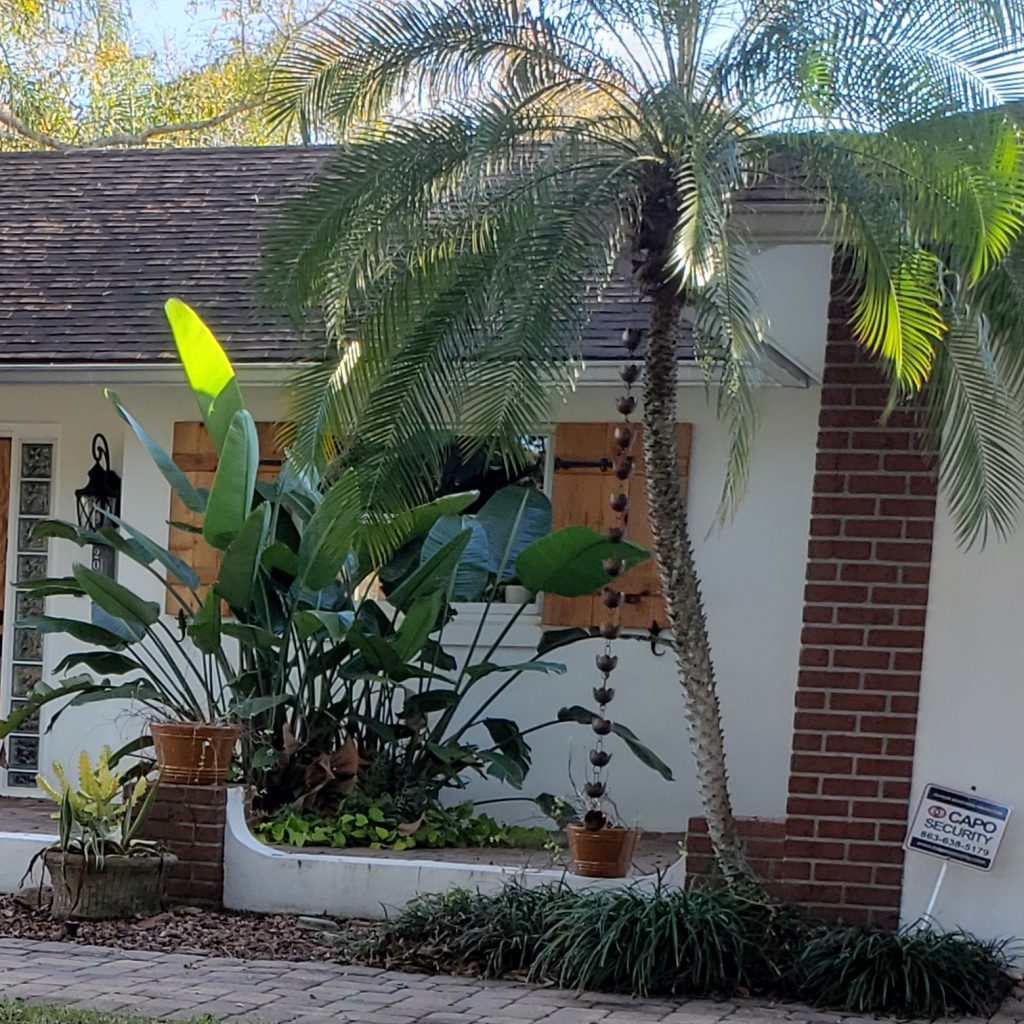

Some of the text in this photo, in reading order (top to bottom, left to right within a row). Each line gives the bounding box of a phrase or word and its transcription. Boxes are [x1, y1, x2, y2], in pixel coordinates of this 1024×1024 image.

[924, 818, 994, 845] SECURITY
[949, 811, 997, 834] CAPO
[920, 830, 989, 856] 863-638-5179
